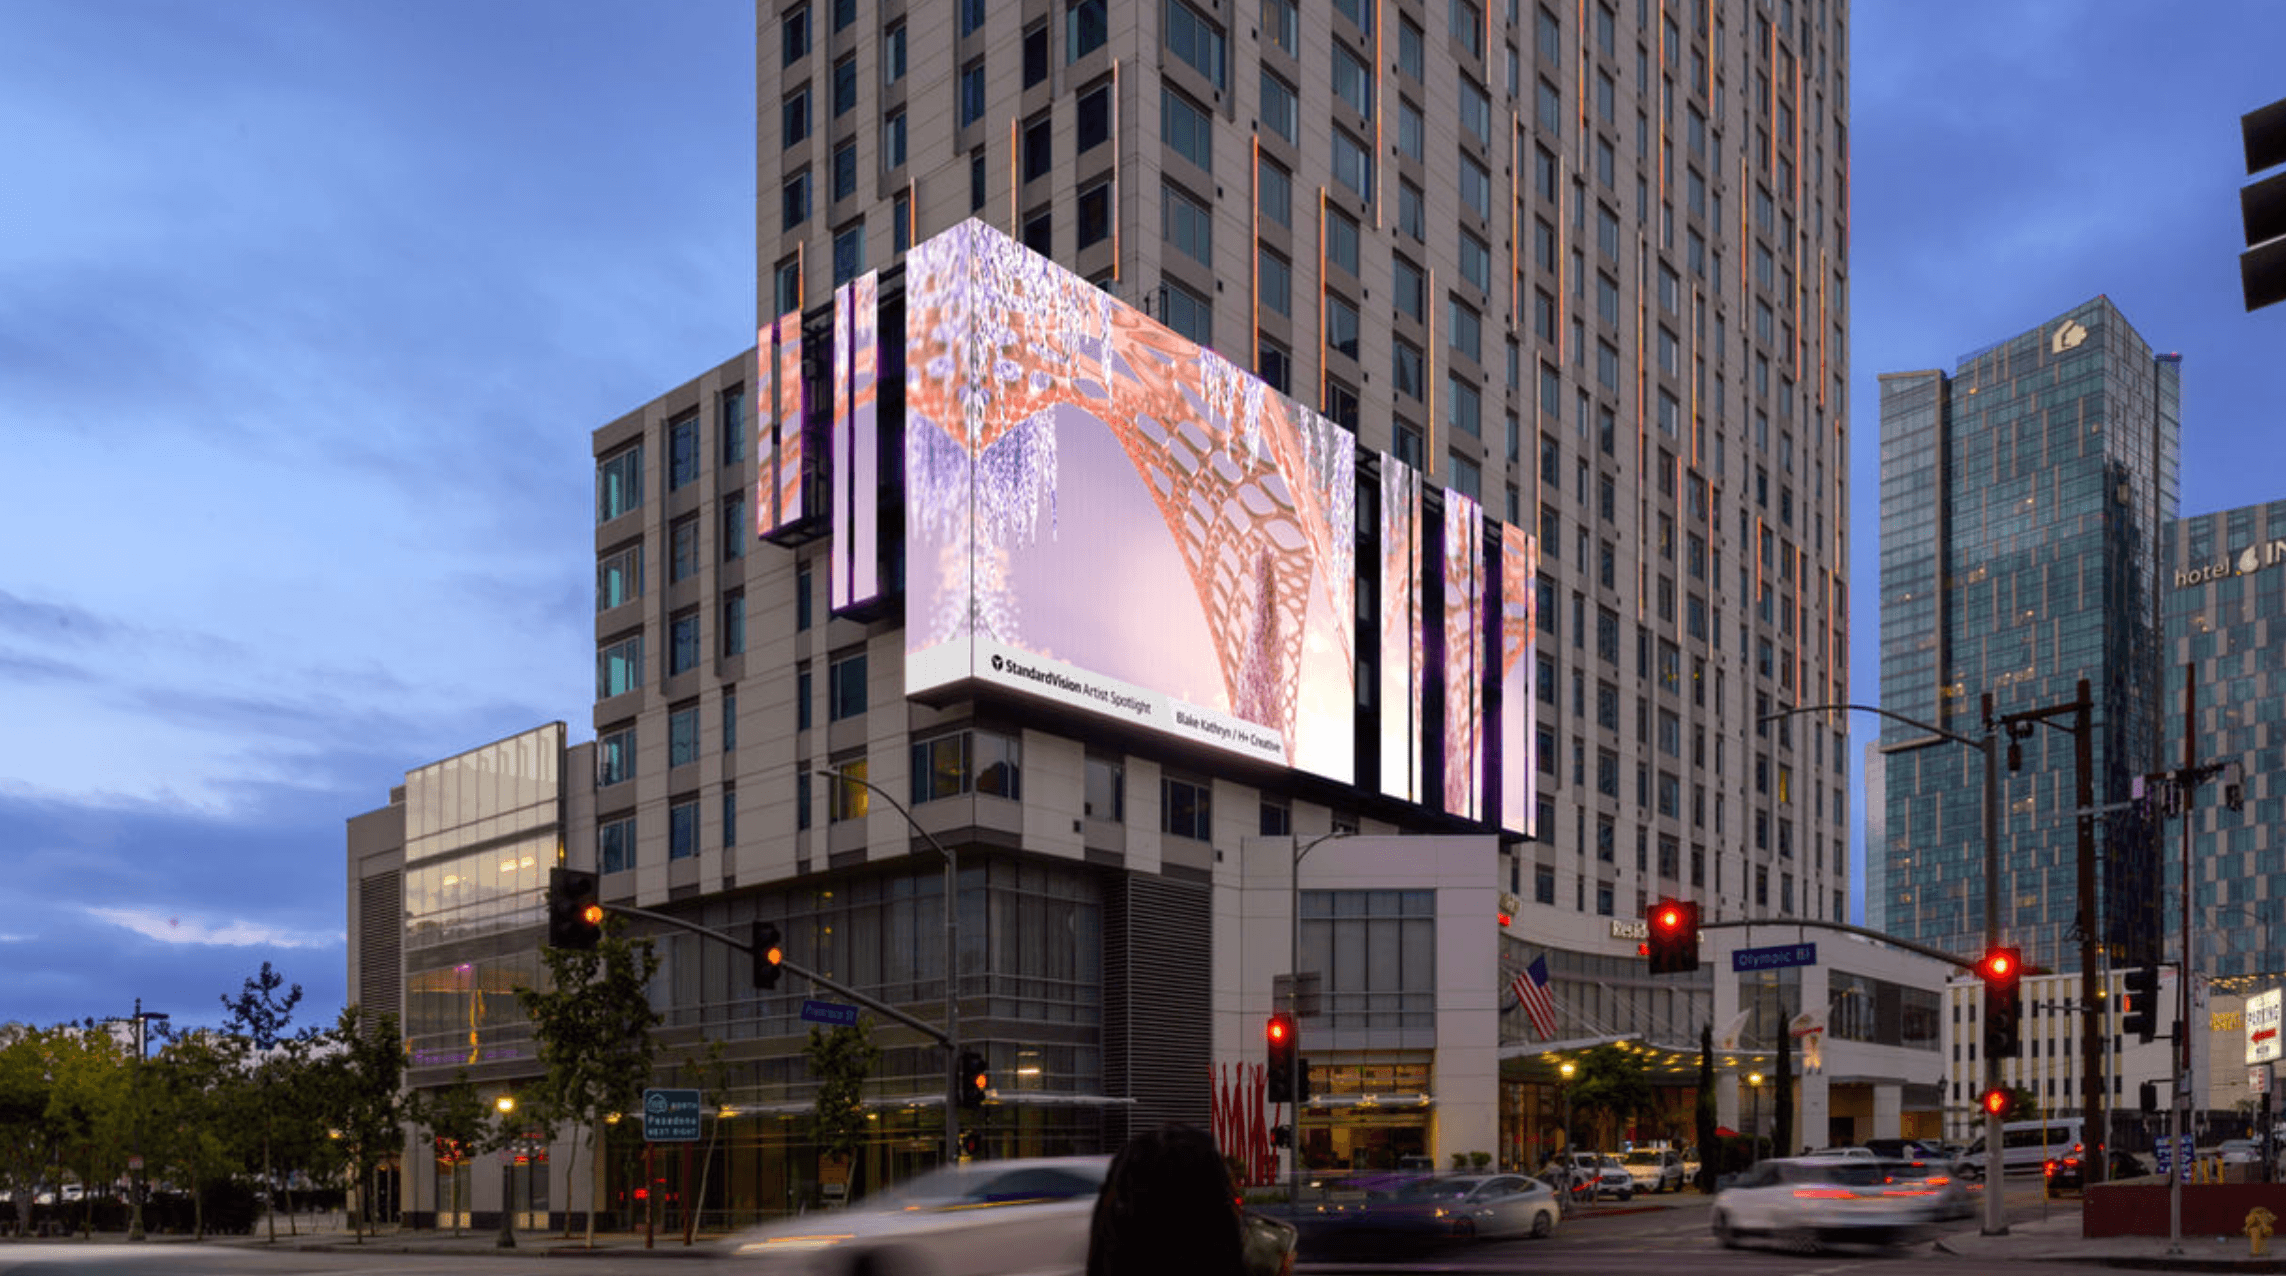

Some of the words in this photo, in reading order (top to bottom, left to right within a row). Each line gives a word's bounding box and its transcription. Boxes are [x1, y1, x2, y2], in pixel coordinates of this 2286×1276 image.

[2175, 557, 2231, 588] hotel
[1005, 659, 1082, 694] StandardVision
[1082, 683, 1109, 703] Artist
[1110, 691, 1152, 715] Spotlight
[1176, 711, 1200, 729] Blake
[1200, 718, 1232, 740] Kathryn
[1250, 733, 1281, 753] Creative
[1737, 951, 1792, 967] Olympic
